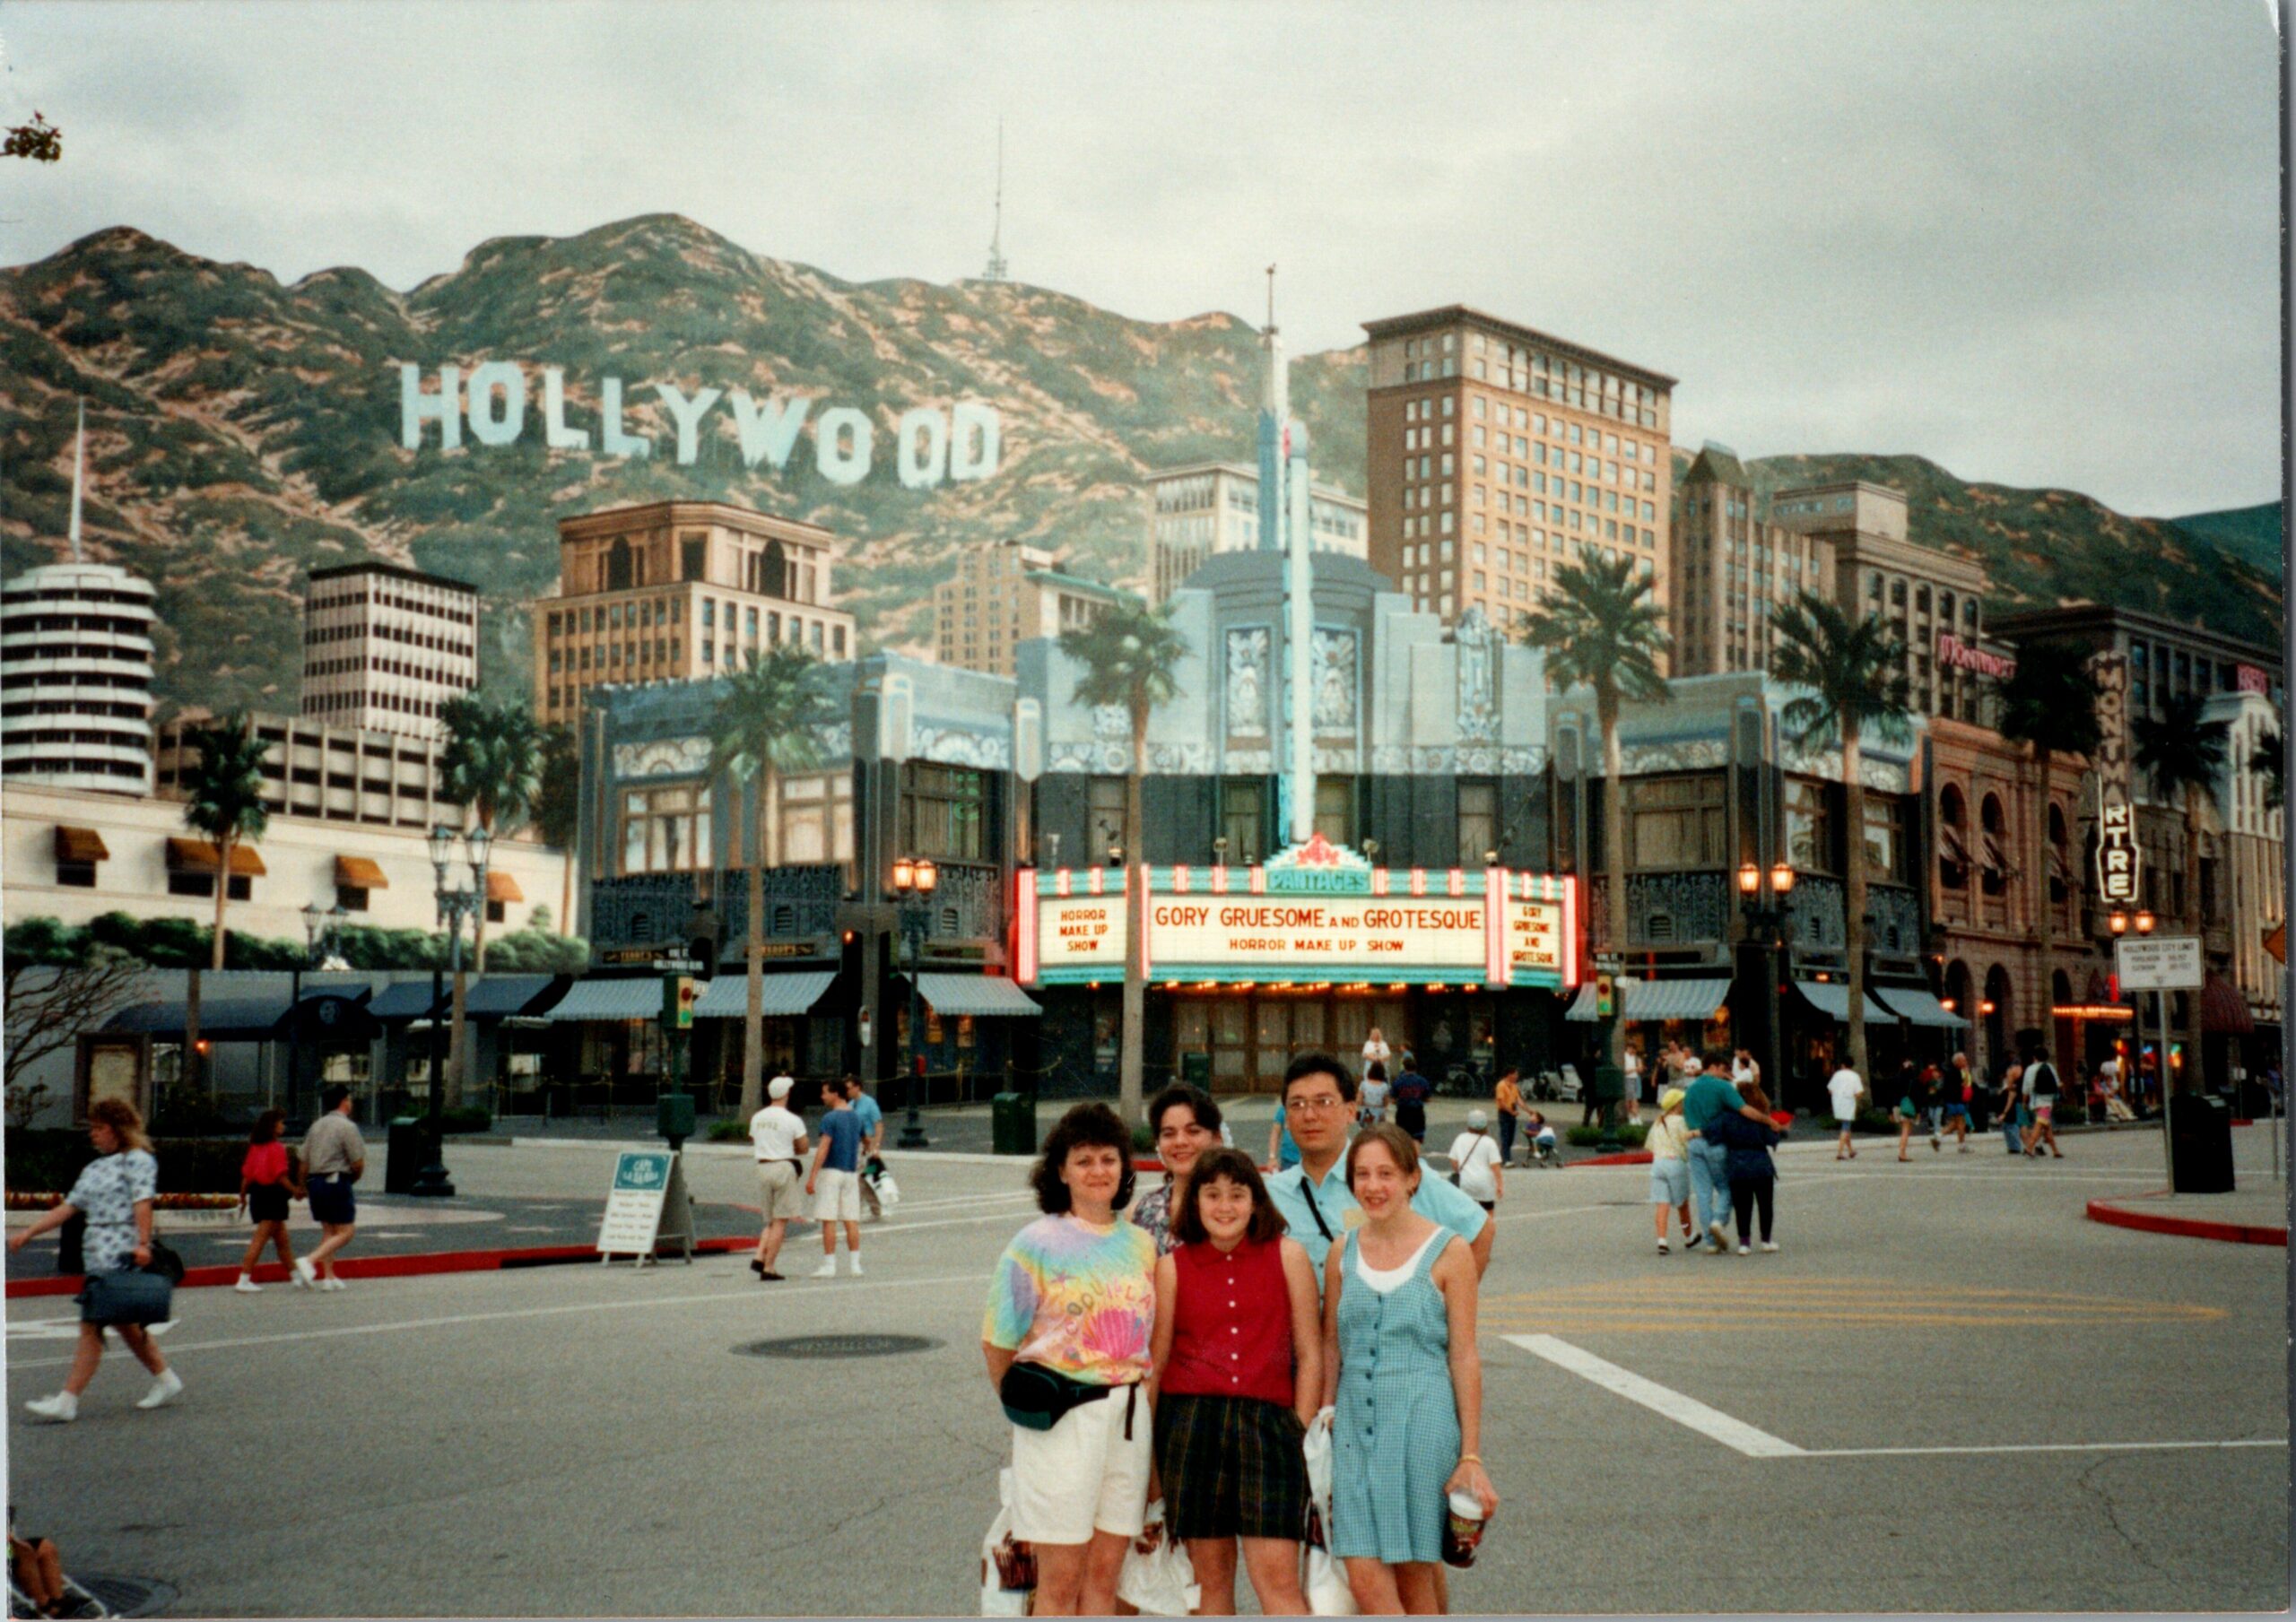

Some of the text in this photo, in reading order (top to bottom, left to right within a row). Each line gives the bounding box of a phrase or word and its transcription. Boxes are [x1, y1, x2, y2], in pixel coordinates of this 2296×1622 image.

[401, 360, 1001, 490] HOLLYWOOD
[2095, 666, 2130, 896] MONTMARTRE
[1061, 909, 1106, 921] HORROR
[1154, 906, 1481, 929] GORY GRUESOME AND GROTESQUE
[1522, 906, 1542, 917] GORY
[1059, 924, 1109, 937] MAKE UP
[1513, 920, 1551, 933] GRUESOME
[1067, 940, 1098, 951] SHOW
[1230, 939, 1404, 951] HORROR MAKE UP SHOW
[1524, 937, 1540, 947] AND
[1512, 950, 1553, 964] GROTESQUE
